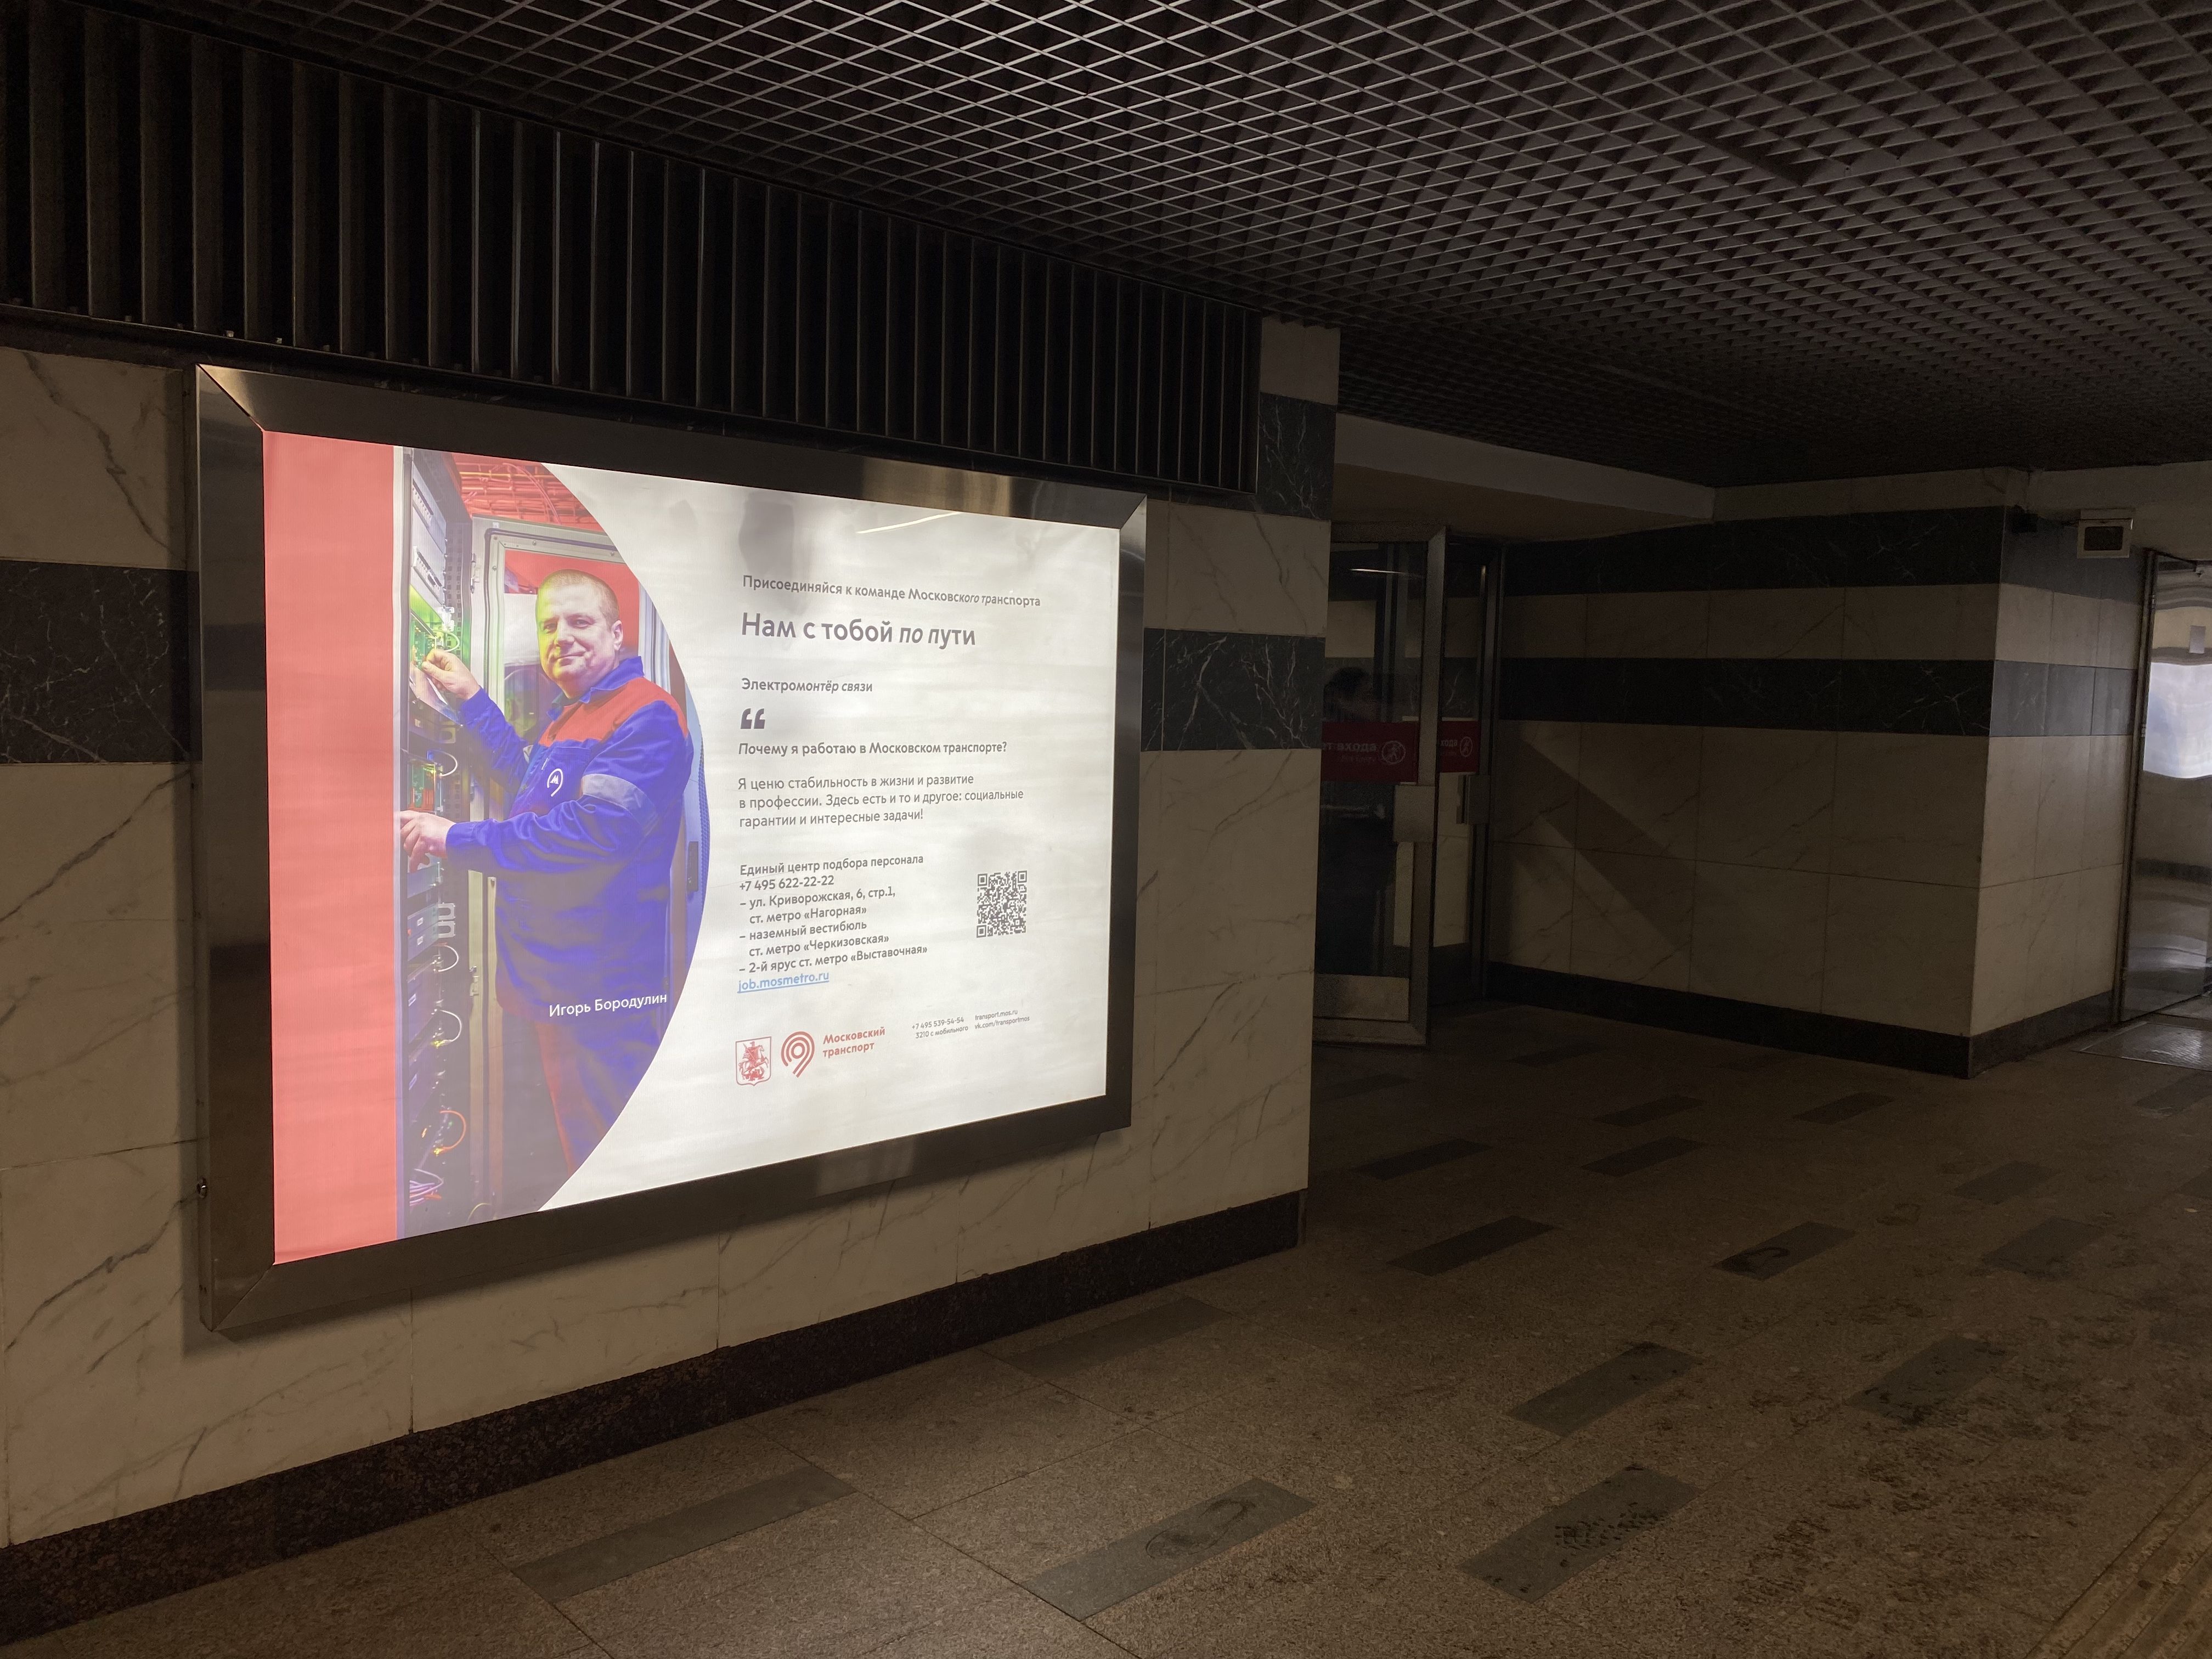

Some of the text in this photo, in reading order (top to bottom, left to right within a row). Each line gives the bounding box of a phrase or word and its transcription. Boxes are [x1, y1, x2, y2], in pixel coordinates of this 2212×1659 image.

[743, 574, 1041, 608] Присоединяйся к команде Московского транспорта
[742, 612, 975, 650] Нам с тобой по пути
[741, 678, 873, 694] Электромонтёр связи
[738, 741, 1007, 757] Почему я работаю в Московском транспорте?
[738, 775, 974, 791] Я ценю стабильность в жизни и развитие
[739, 791, 1024, 811] в профессии. Здесь есть и то и другое: социальные
[740, 808, 923, 830] гарантии и интересные задачи!
[740, 855, 924, 876] Единый центр подбора персонала
[740, 875, 834, 891] +7 495 622-22-22
[749, 898, 766, 910] ул.
[769, 890, 854, 908] Криворожская,
[856, 888, 866, 901] 6,
[868, 886, 896, 900] стр.1,
[749, 905, 867, 925] ст. метро «Нагорная»
[749, 925, 806, 941] наземный
[810, 921, 867, 935] вестибюль
[749, 934, 889, 957] ст. метро «Черкизовская»
[749, 961, 768, 973] 2-й
[770, 960, 796, 973] ярус
[799, 957, 812, 968] ст.
[815, 954, 848, 967] метро
[850, 945, 928, 961] «Выставочная»
[738, 971, 830, 992] job.mosmetro.ru
[549, 994, 667, 1017] Игорь Бородулин
[975, 1009, 1018, 1020] transport.mos.ru
[915, 1031, 929, 1039] 3210
[935, 1025, 968, 1036] мобильного
[933, 1017, 964, 1028] 539-54-54
[974, 1015, 1030, 1029] vk.com/transportmos
[823, 1026, 885, 1045] Московский
[823, 1042, 874, 1059] транспорт
